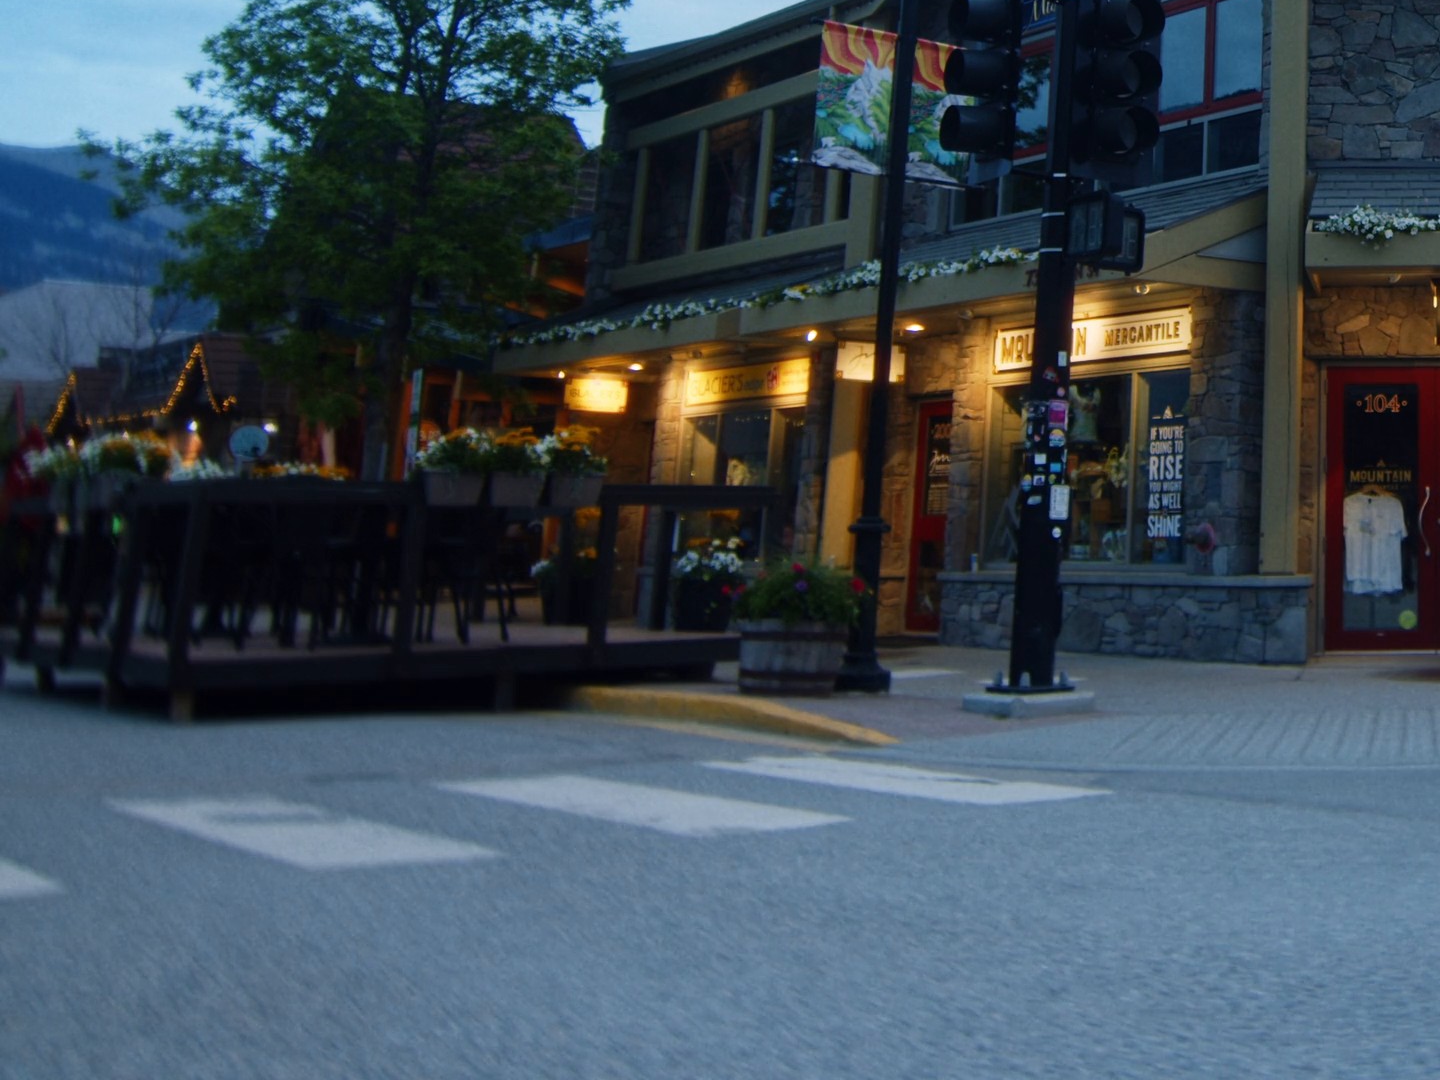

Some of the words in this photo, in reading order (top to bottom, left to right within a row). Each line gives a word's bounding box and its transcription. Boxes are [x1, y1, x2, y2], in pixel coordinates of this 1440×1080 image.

[1001, 327, 1087, 364] MOUN
[1104, 321, 1180, 347] MERCANTILE
[1364, 394, 1400, 413] 104
[1150, 427, 1157, 441] IF
[1158, 425, 1184, 440] YOU'RE
[1150, 441, 1173, 454] GOING
[1174, 440, 1184, 453] TO
[1149, 455, 1183, 480] RISE
[1350, 470, 1412, 483] MOUNTAIN
[1149, 481, 1162, 492] YOU
[1163, 481, 1182, 492] MIGHT
[1148, 493, 1160, 509] AS
[1162, 493, 1182, 509] WELL
[1147, 515, 1182, 538] SHINE
